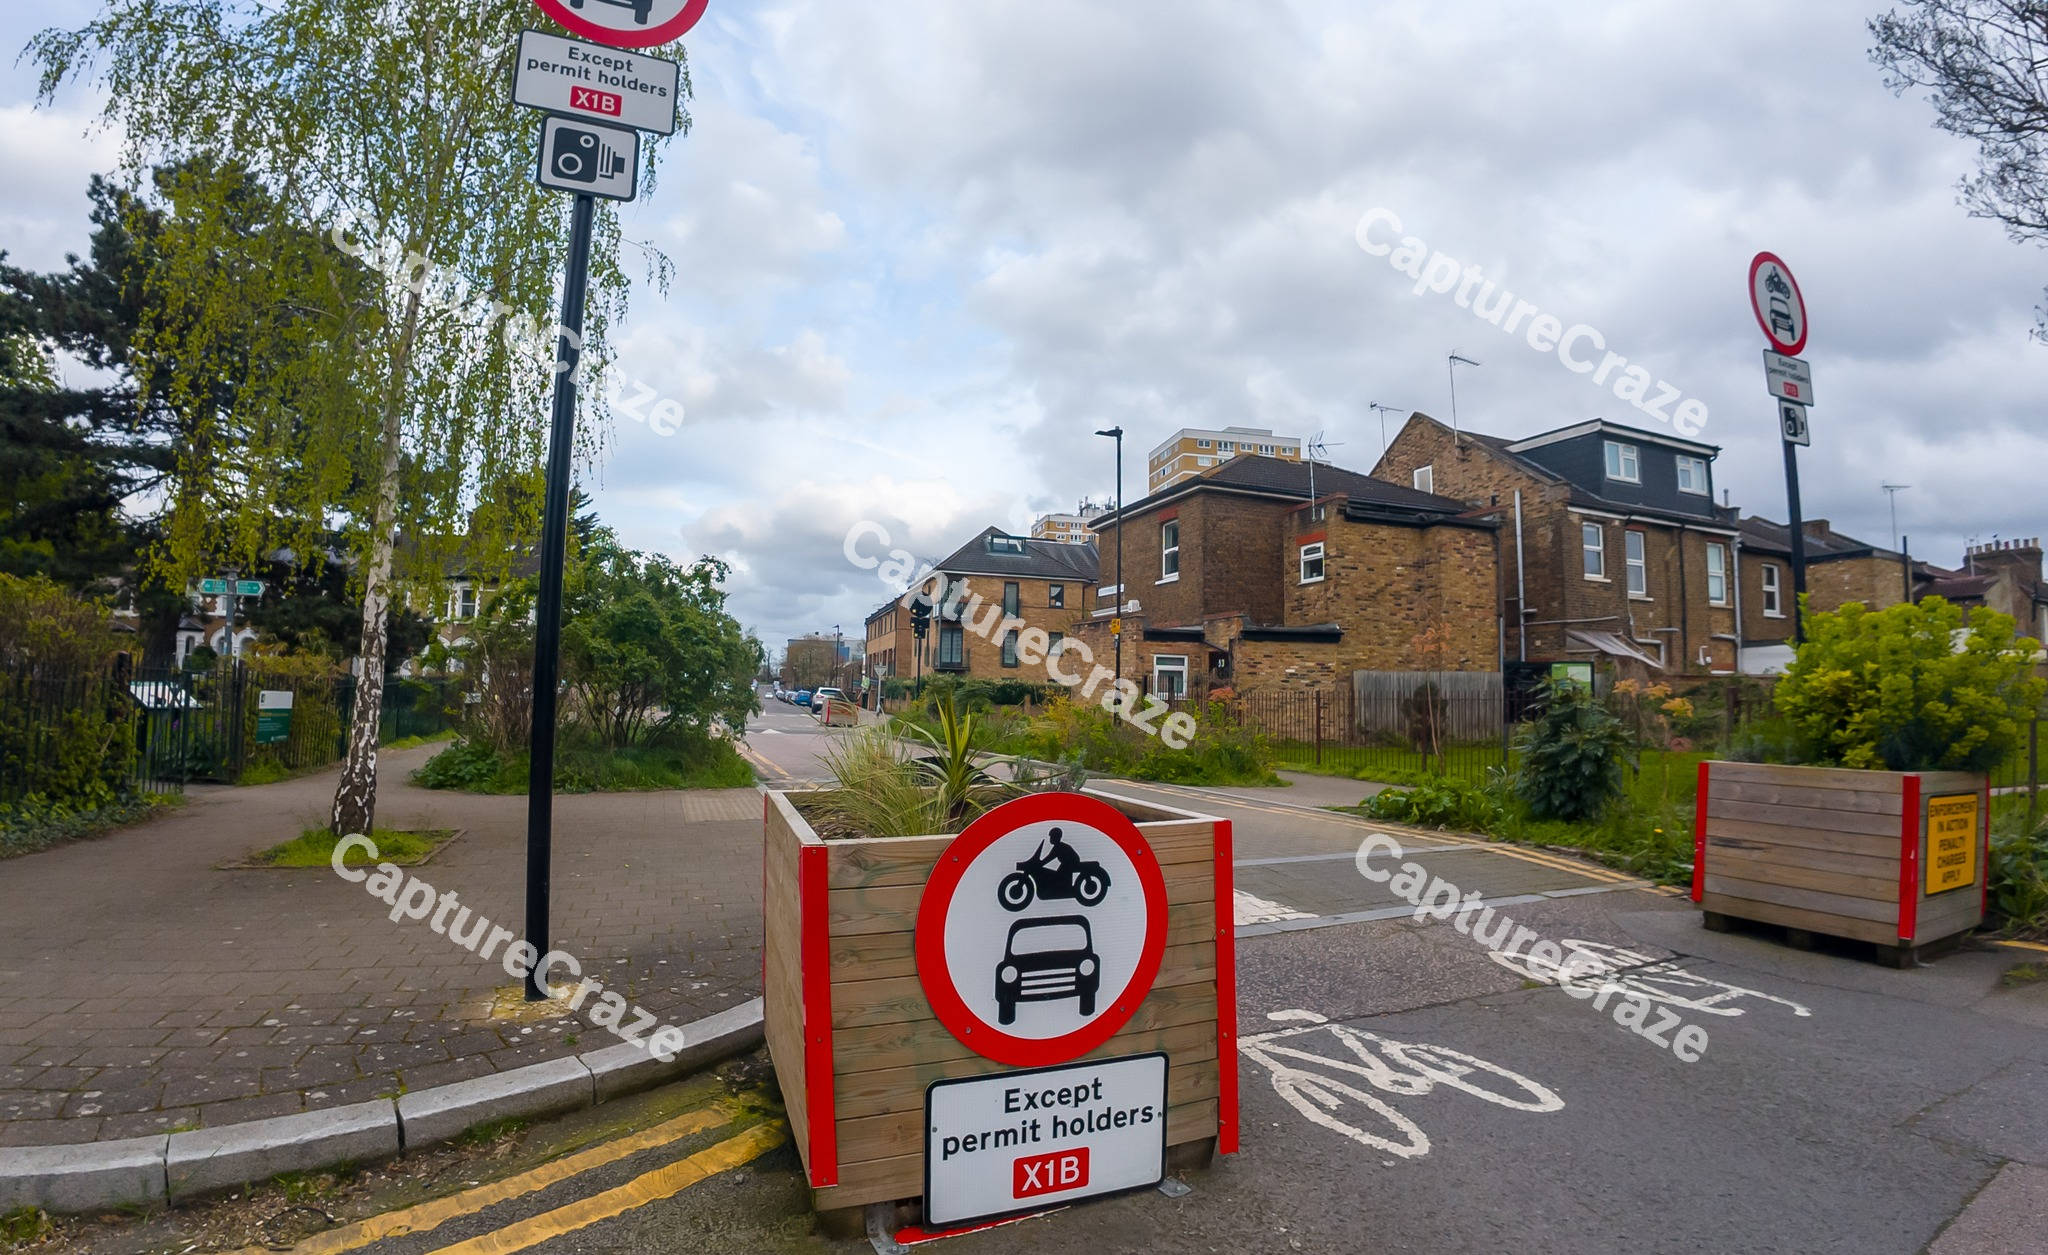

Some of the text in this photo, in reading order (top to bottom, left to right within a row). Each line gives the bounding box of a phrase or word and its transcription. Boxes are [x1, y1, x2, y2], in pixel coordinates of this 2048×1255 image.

[527, 57, 667, 97] permit holders
[568, 46, 633, 73] Except
[576, 89, 615, 112] X1B
[1004, 1077, 1103, 1115] Except
[942, 1105, 1154, 1161] permit holders
[1021, 1156, 1080, 1192] X1B
